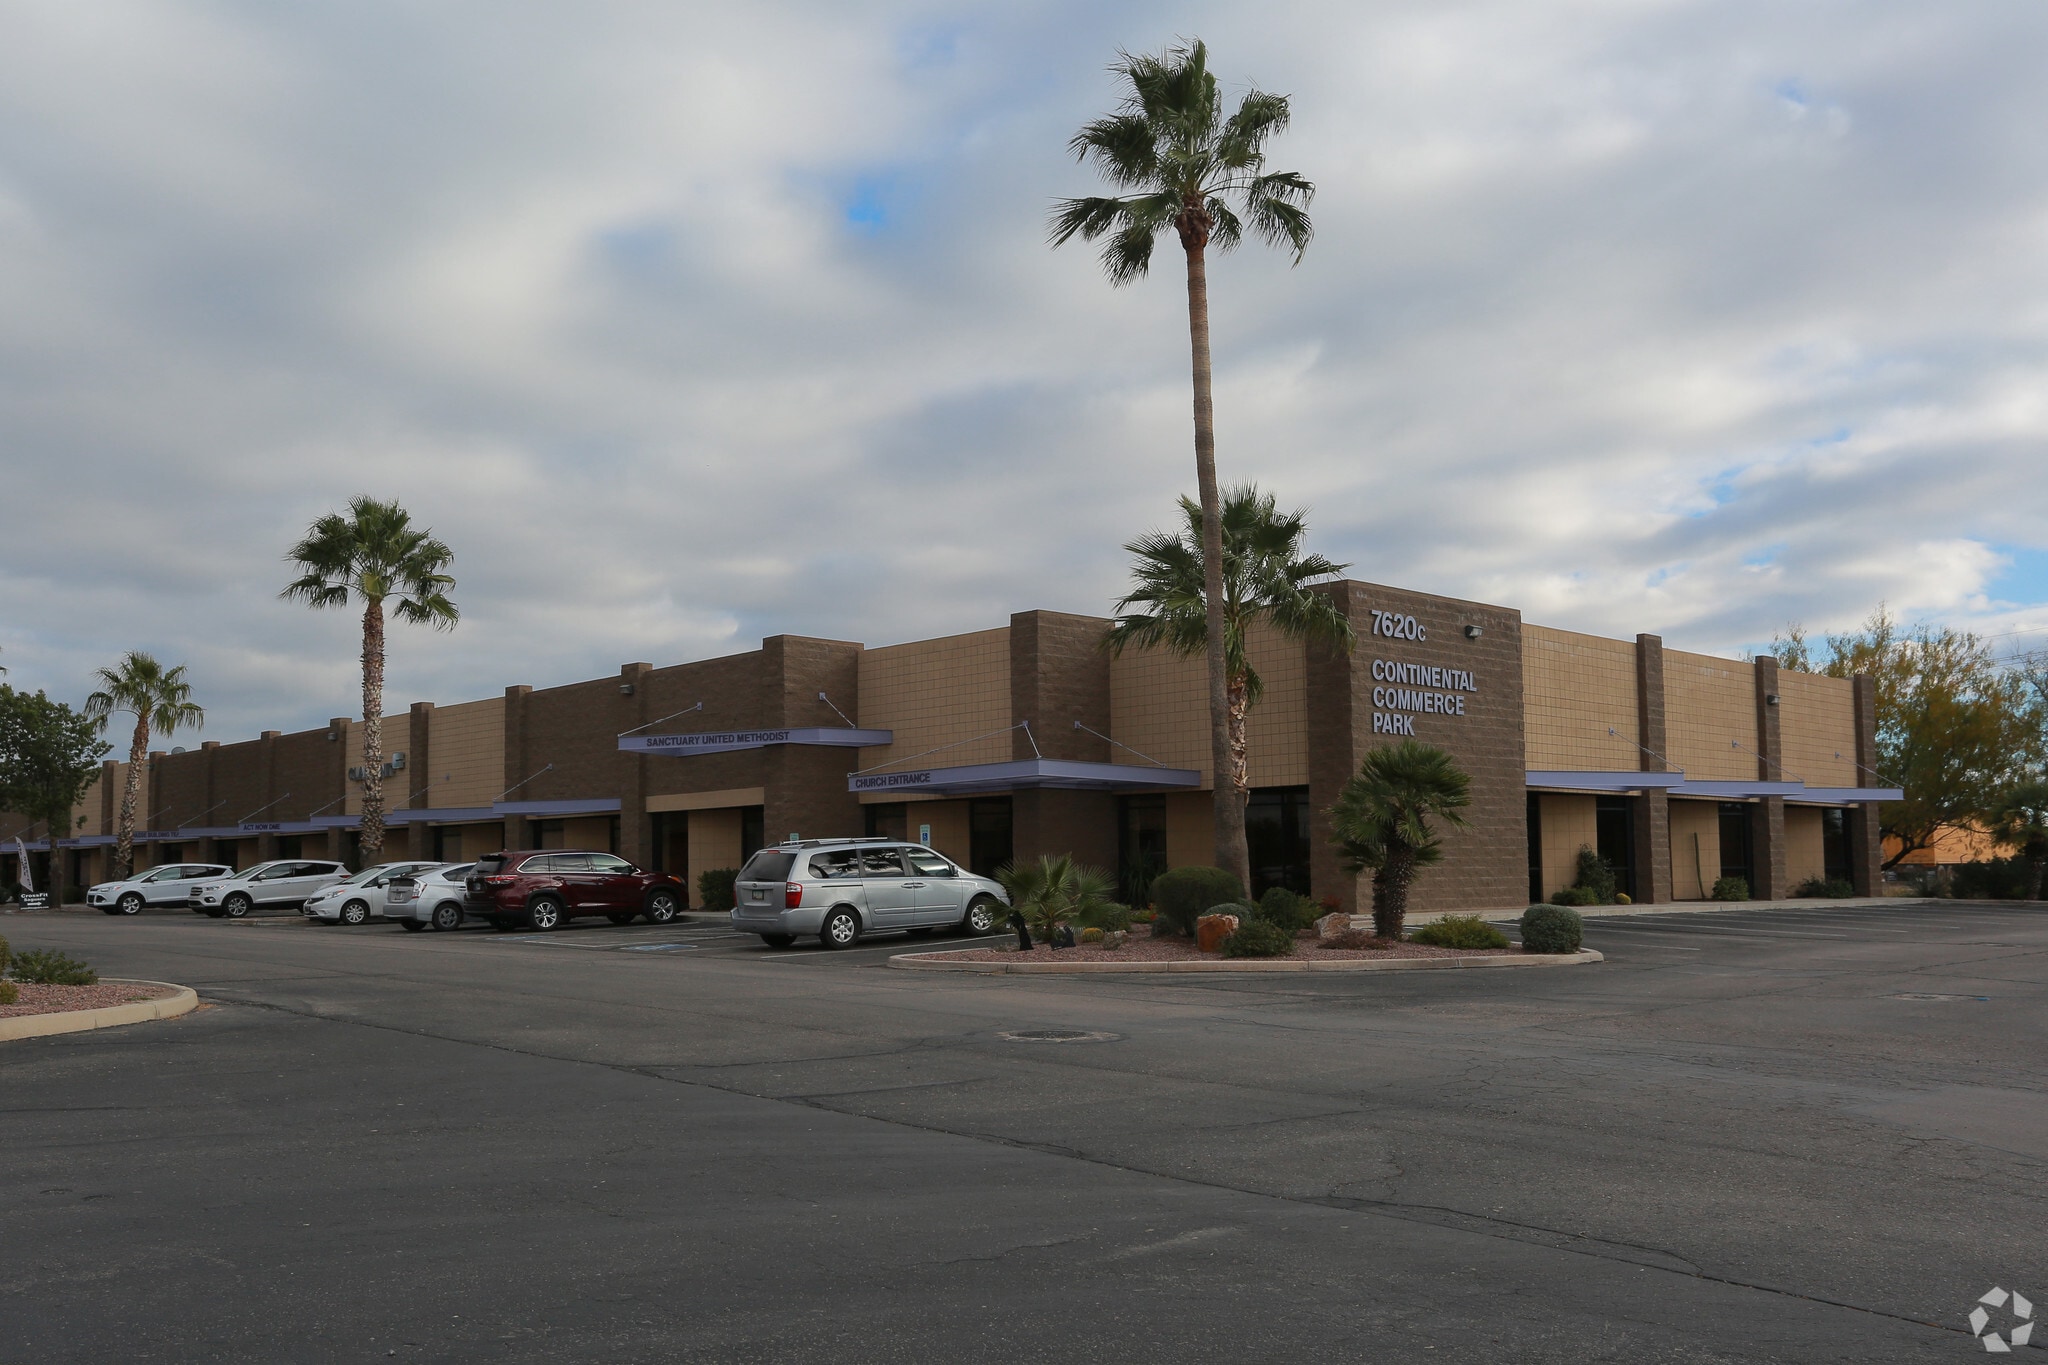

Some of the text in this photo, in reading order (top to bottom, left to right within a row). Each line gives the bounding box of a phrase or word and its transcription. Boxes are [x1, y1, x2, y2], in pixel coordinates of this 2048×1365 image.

[1372, 659, 1477, 692] CONTINENTAL
[1373, 686, 1465, 716] COMMERCE
[1373, 712, 1415, 736] PARK
[646, 731, 790, 747] SANCTUARY UNITED METHODIST
[855, 773, 931, 788] CHURCH ENTRANCE
